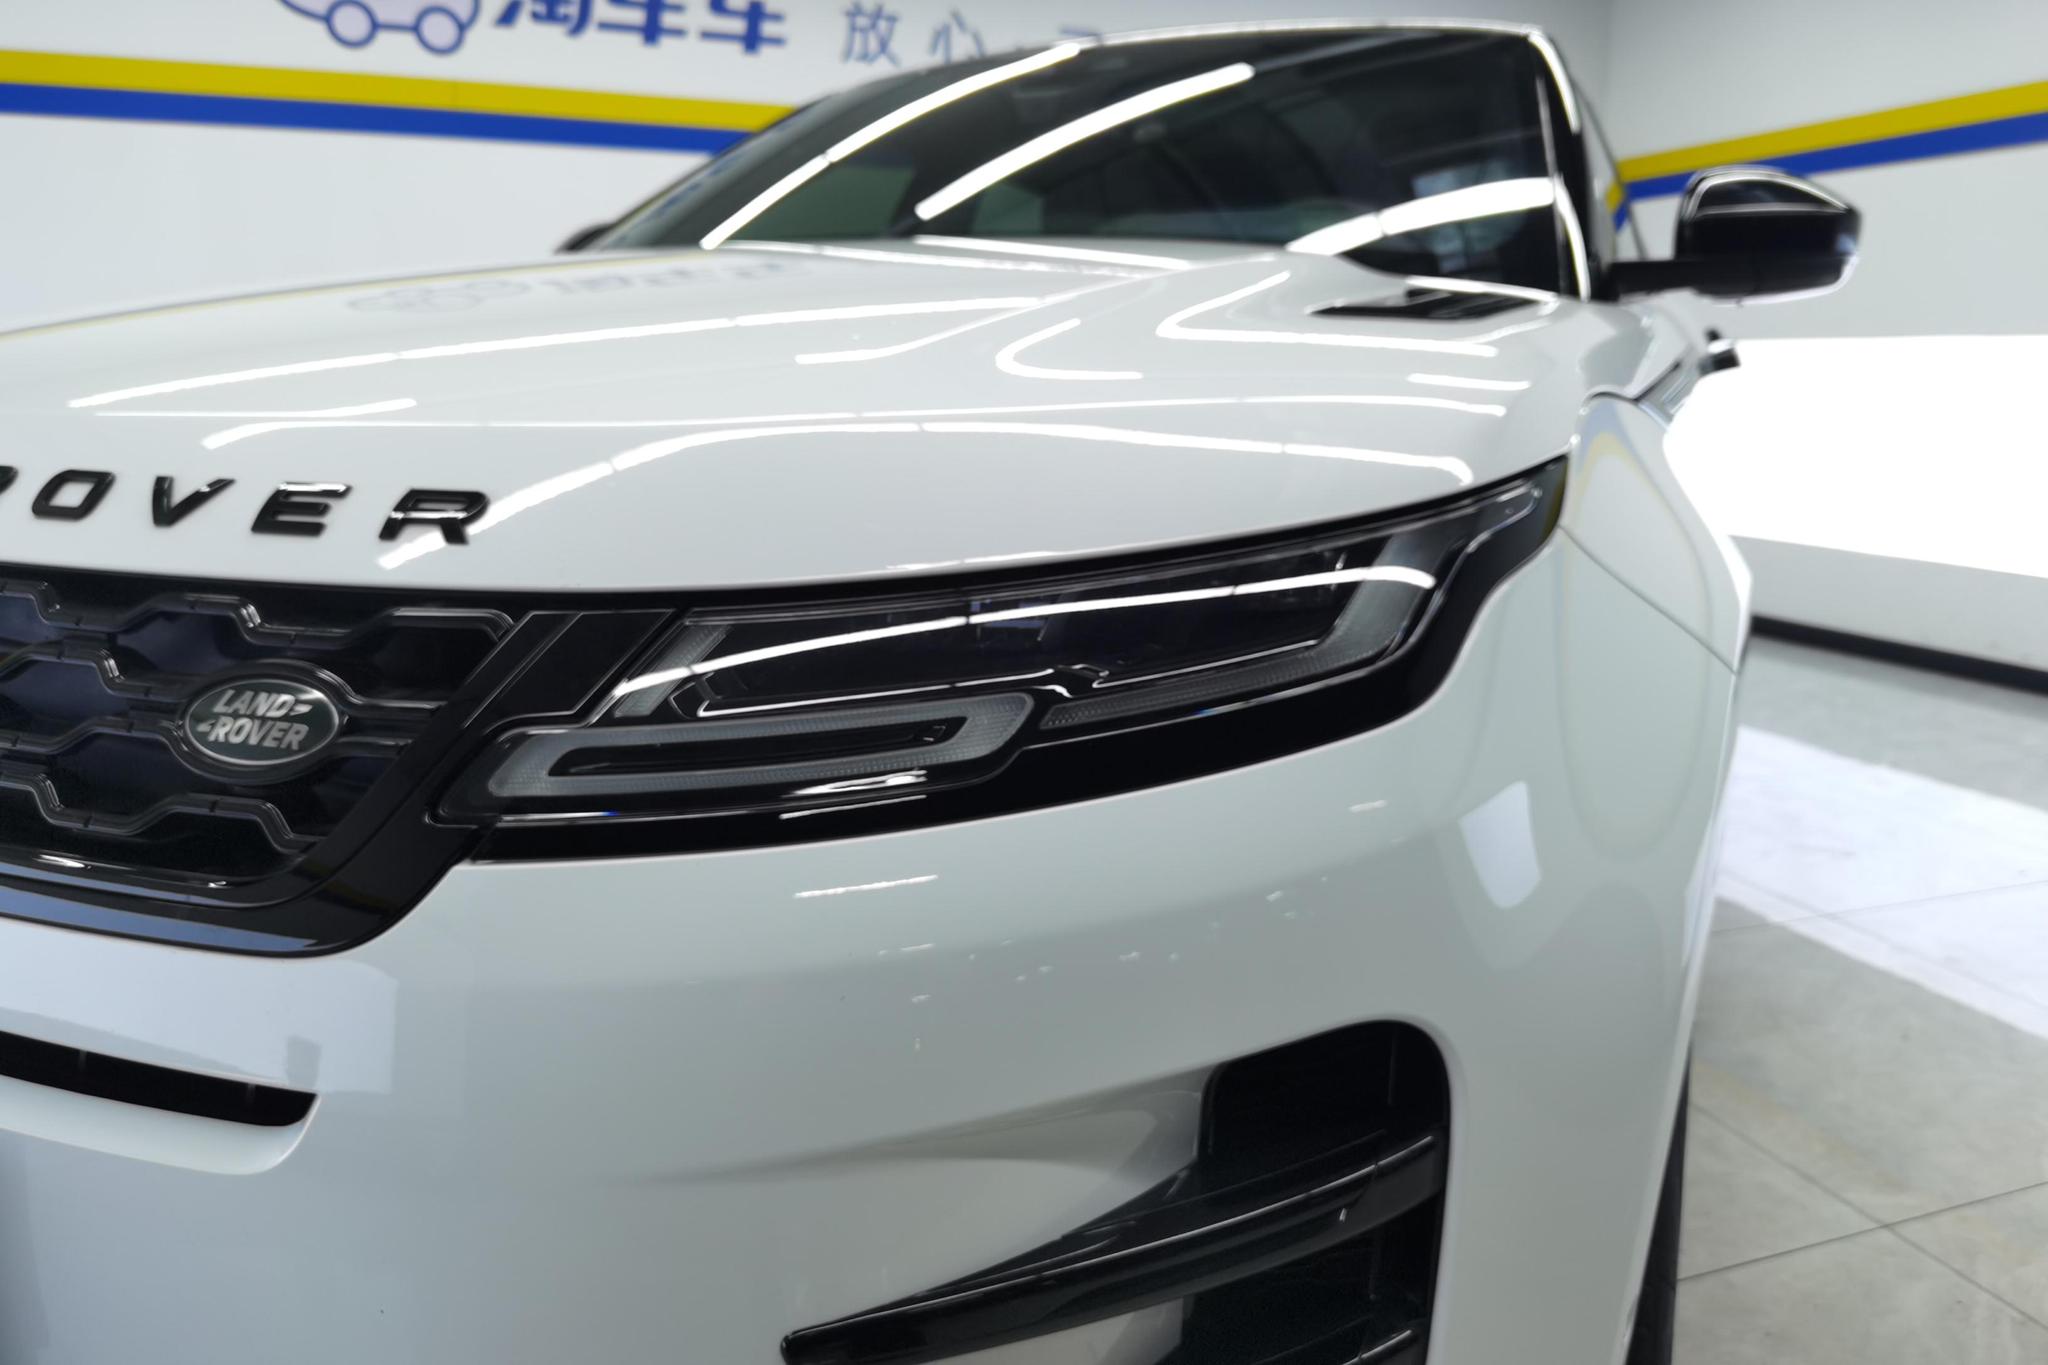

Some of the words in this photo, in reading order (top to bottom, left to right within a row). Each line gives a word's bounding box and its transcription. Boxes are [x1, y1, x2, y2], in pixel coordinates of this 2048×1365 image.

[0, 465, 489, 545] OVER
[213, 689, 295, 718] LAND
[207, 715, 309, 750] ROVER
